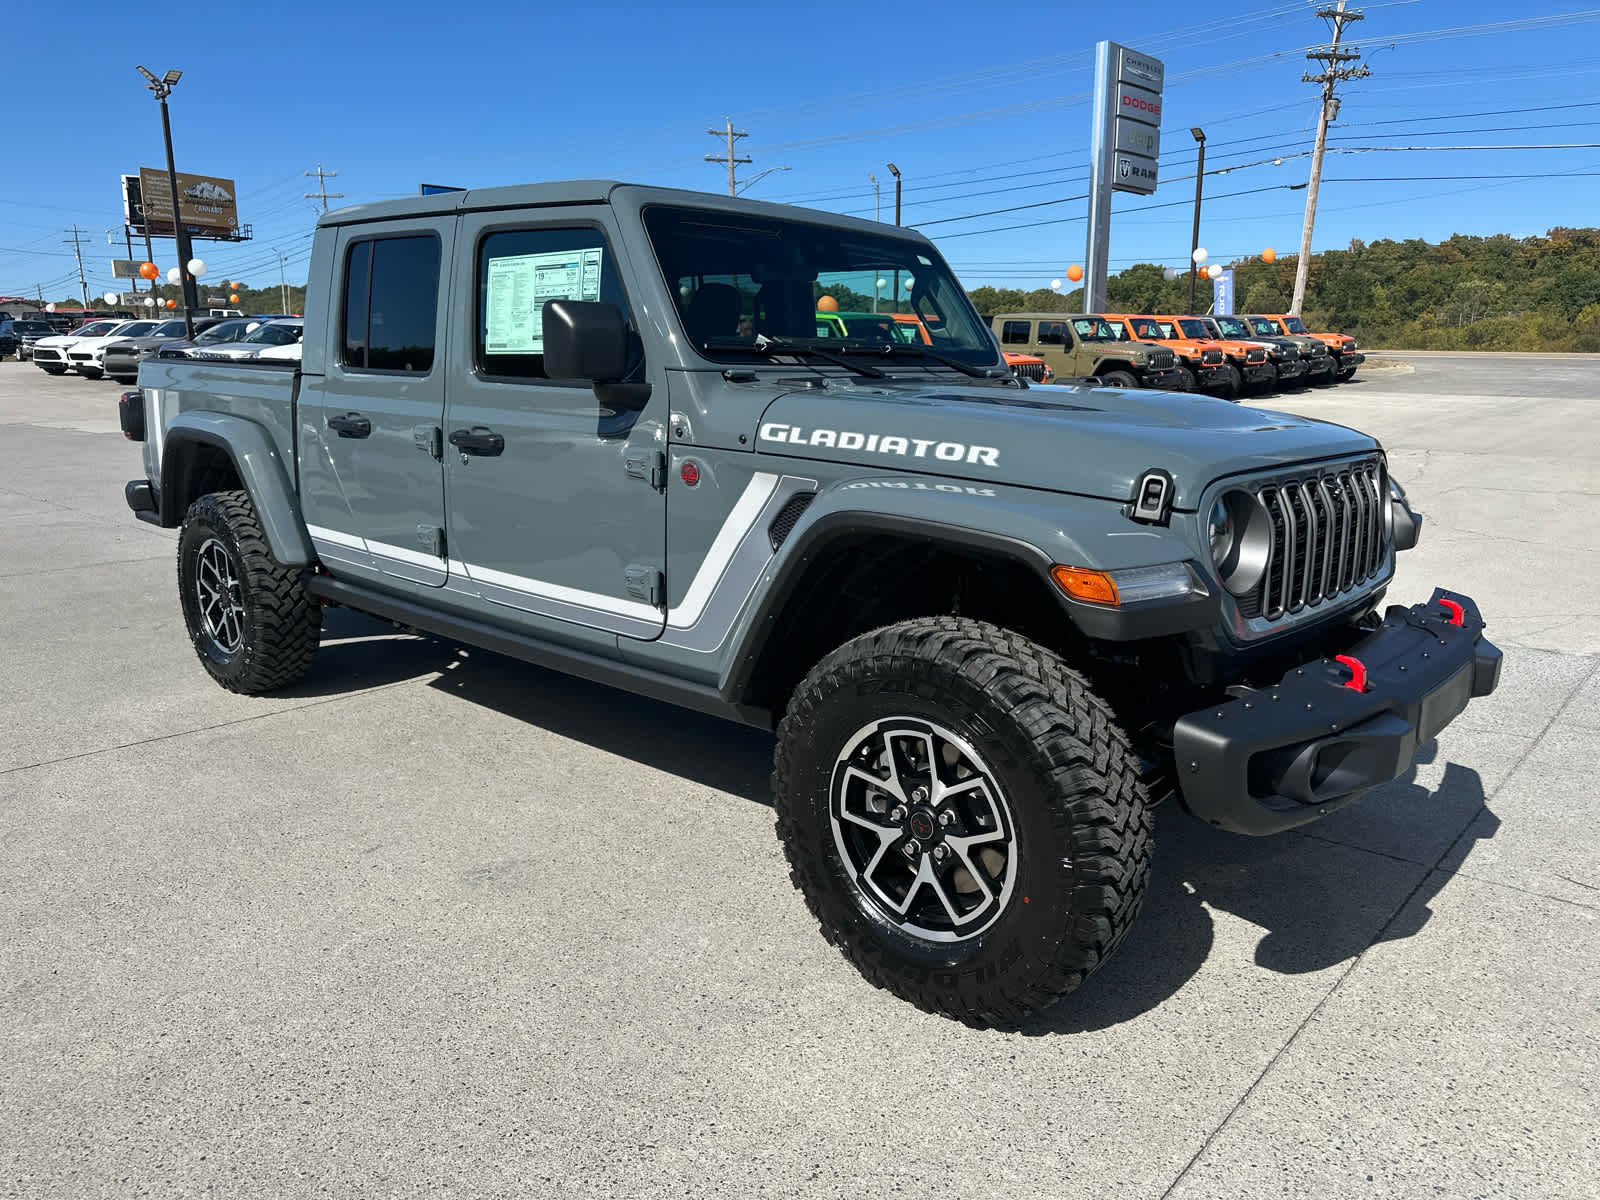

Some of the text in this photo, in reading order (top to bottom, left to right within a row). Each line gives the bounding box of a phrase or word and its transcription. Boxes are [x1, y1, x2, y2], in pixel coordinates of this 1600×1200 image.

[1122, 95, 1161, 115] DODGE
[1132, 166, 1157, 181] RAM
[759, 423, 1001, 467] GLADIATOR
